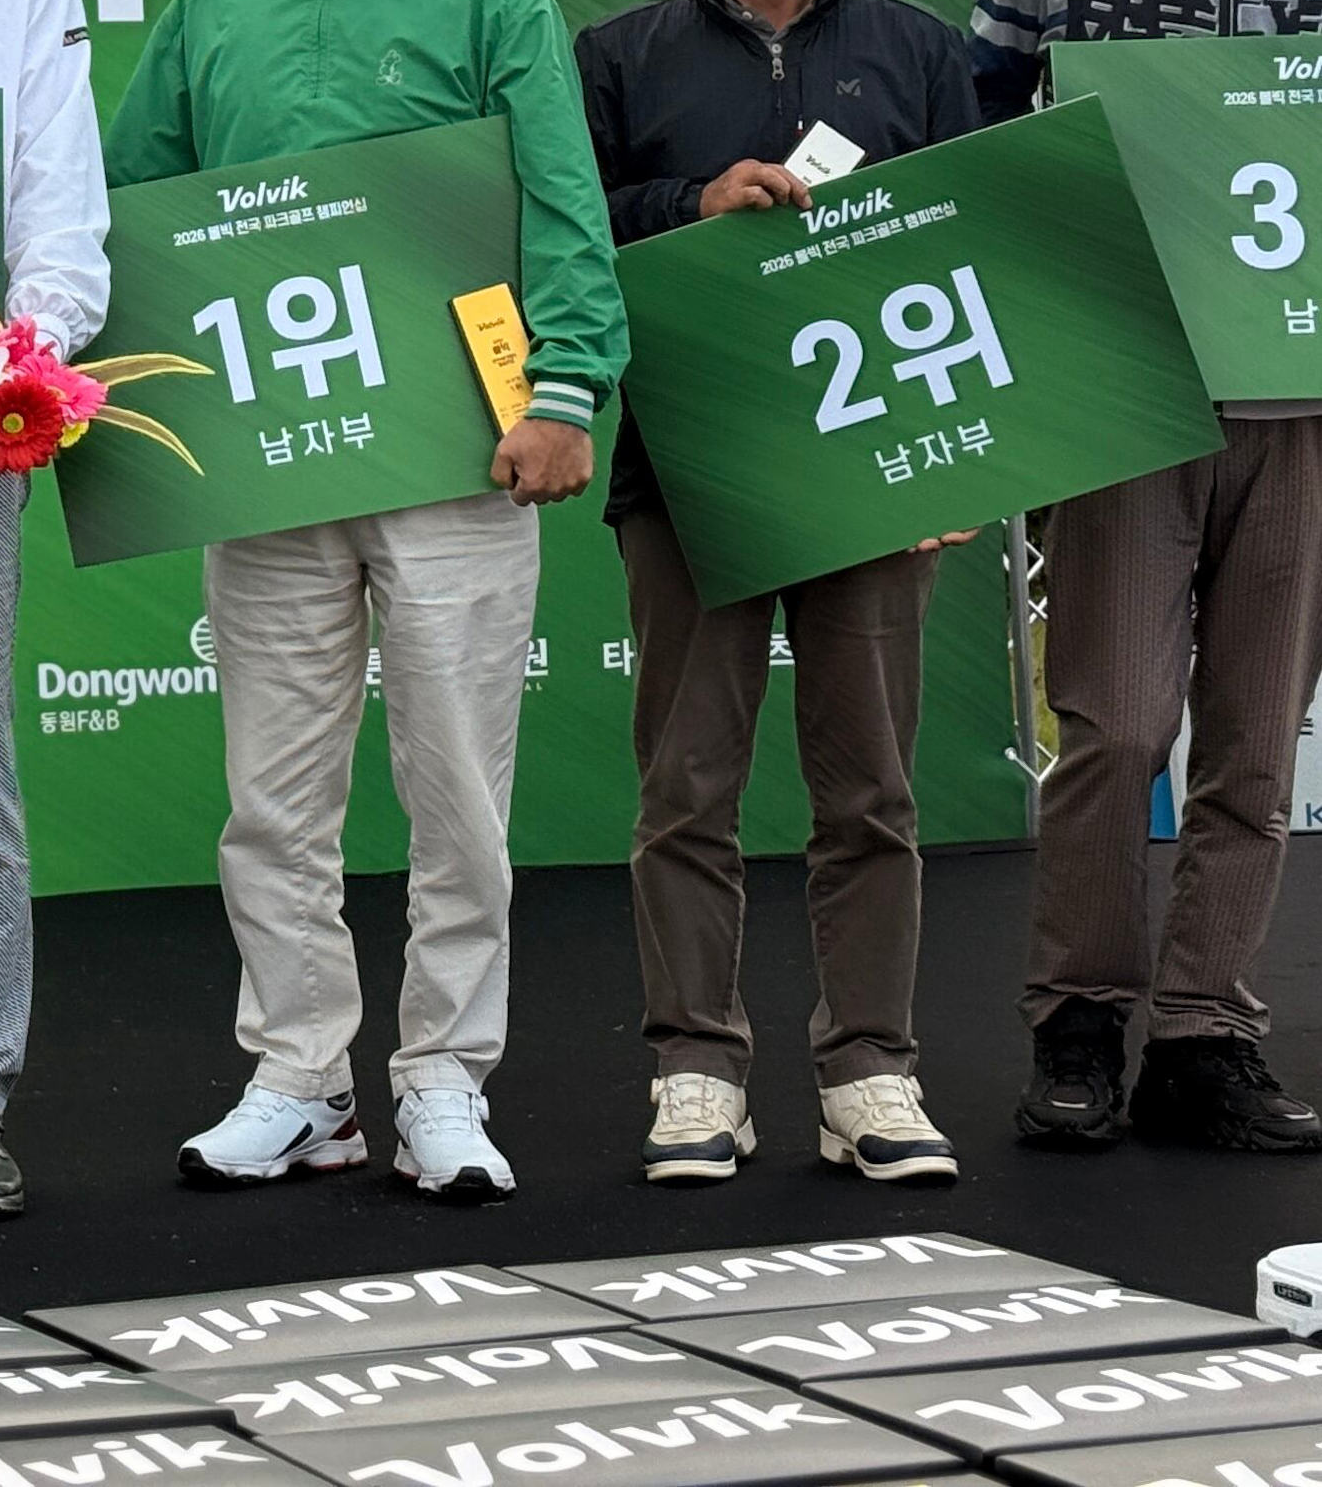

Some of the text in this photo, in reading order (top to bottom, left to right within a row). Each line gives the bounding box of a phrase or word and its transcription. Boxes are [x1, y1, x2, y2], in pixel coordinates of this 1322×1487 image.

[1224, 91, 1257, 106] 2026
[173, 228, 206, 247] 2026
[263, 206, 315, 229] 파크골프
[217, 175, 309, 213] Volvik
[799, 187, 894, 235] Volvik
[760, 253, 795, 276] 2026
[822, 235, 850, 256] 전국
[850, 219, 904, 246] 파크골프
[904, 200, 957, 230] 챔피언십
[192, 264, 387, 404] 1위
[791, 264, 1014, 434] 2위
[260, 412, 376, 467] 남자부
[873, 417, 995, 485] 남자부
[37, 662, 218, 706] Dongwon
[40, 709, 120, 734] 동원F&B
[594, 1234, 1008, 1304] Volvik
[109, 1268, 542, 1354] Volvik
[736, 1280, 1165, 1361] Volvik
[216, 1336, 687, 1419] Volvik
[349, 1398, 853, 1487] Volvik
